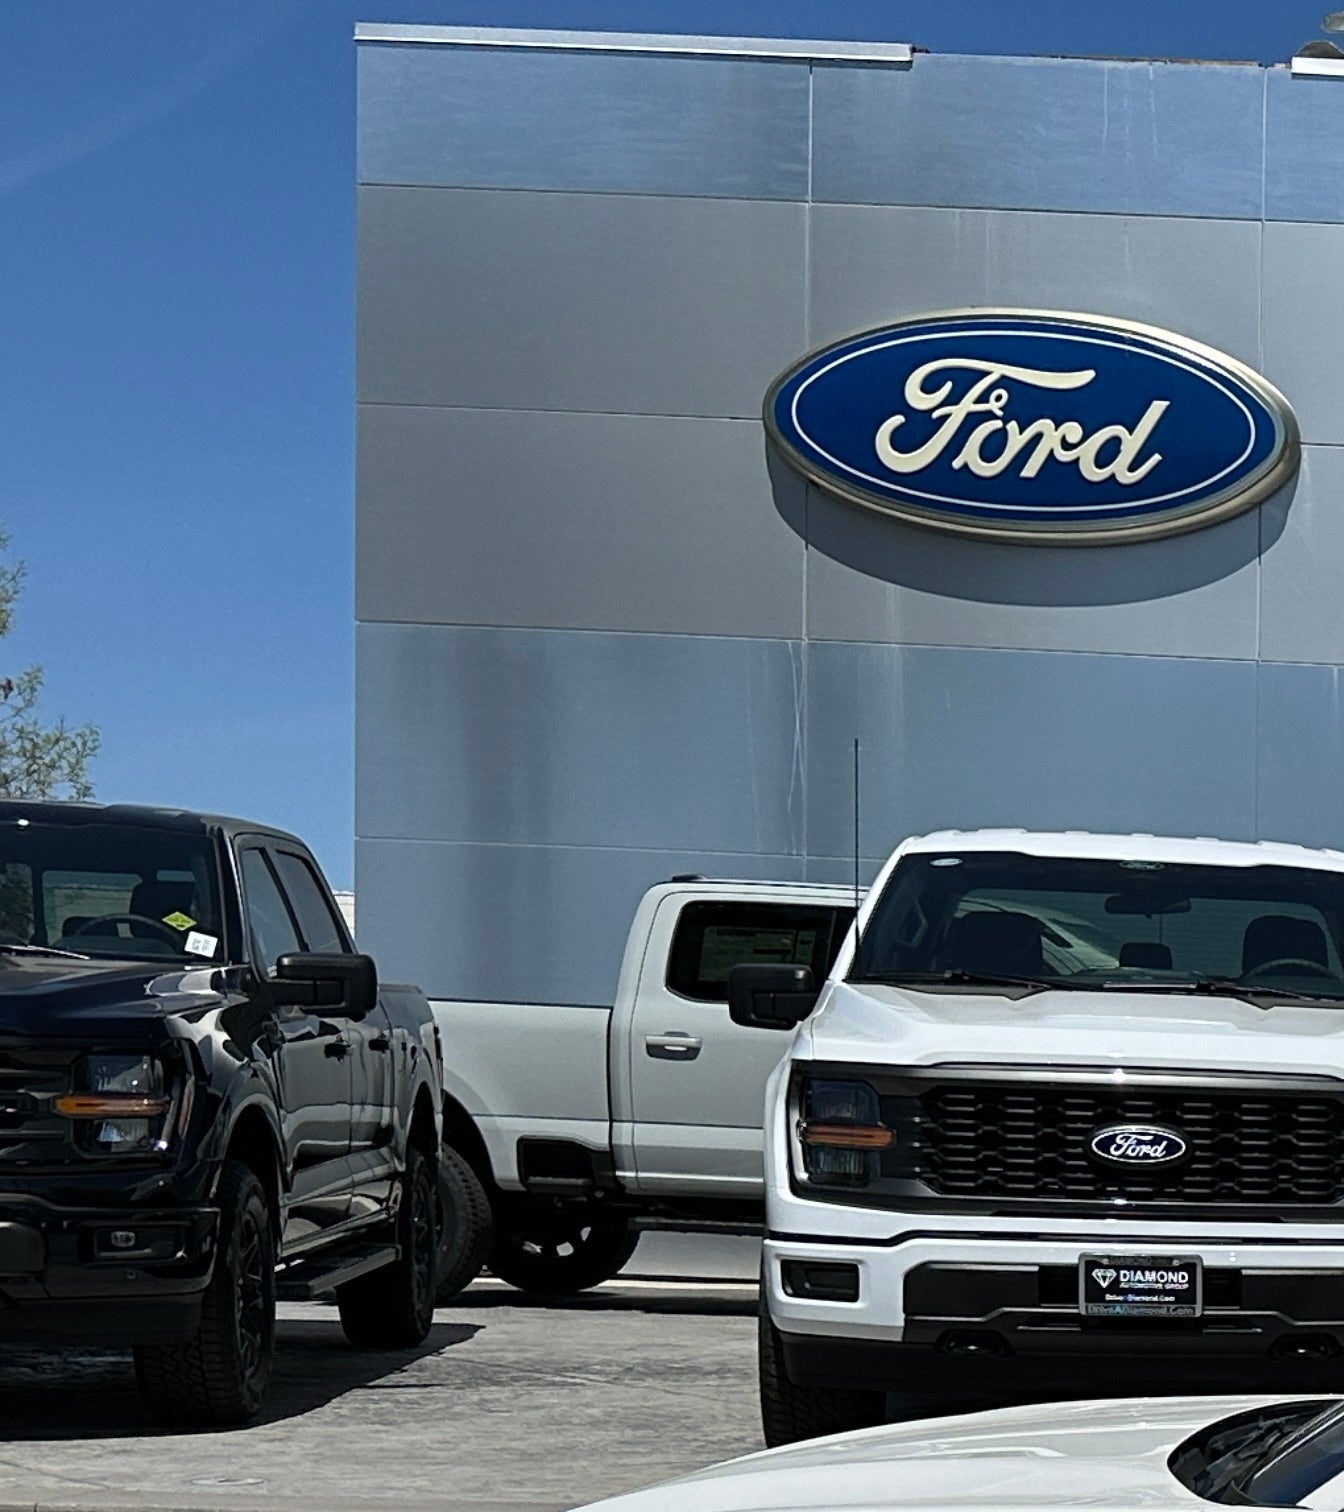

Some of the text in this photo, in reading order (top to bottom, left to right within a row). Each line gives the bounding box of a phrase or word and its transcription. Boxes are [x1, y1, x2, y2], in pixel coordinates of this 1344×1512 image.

[875, 358, 1170, 485] Ford
[1109, 1133, 1168, 1157] Ford
[1119, 1269, 1189, 1283] DIAMOND
